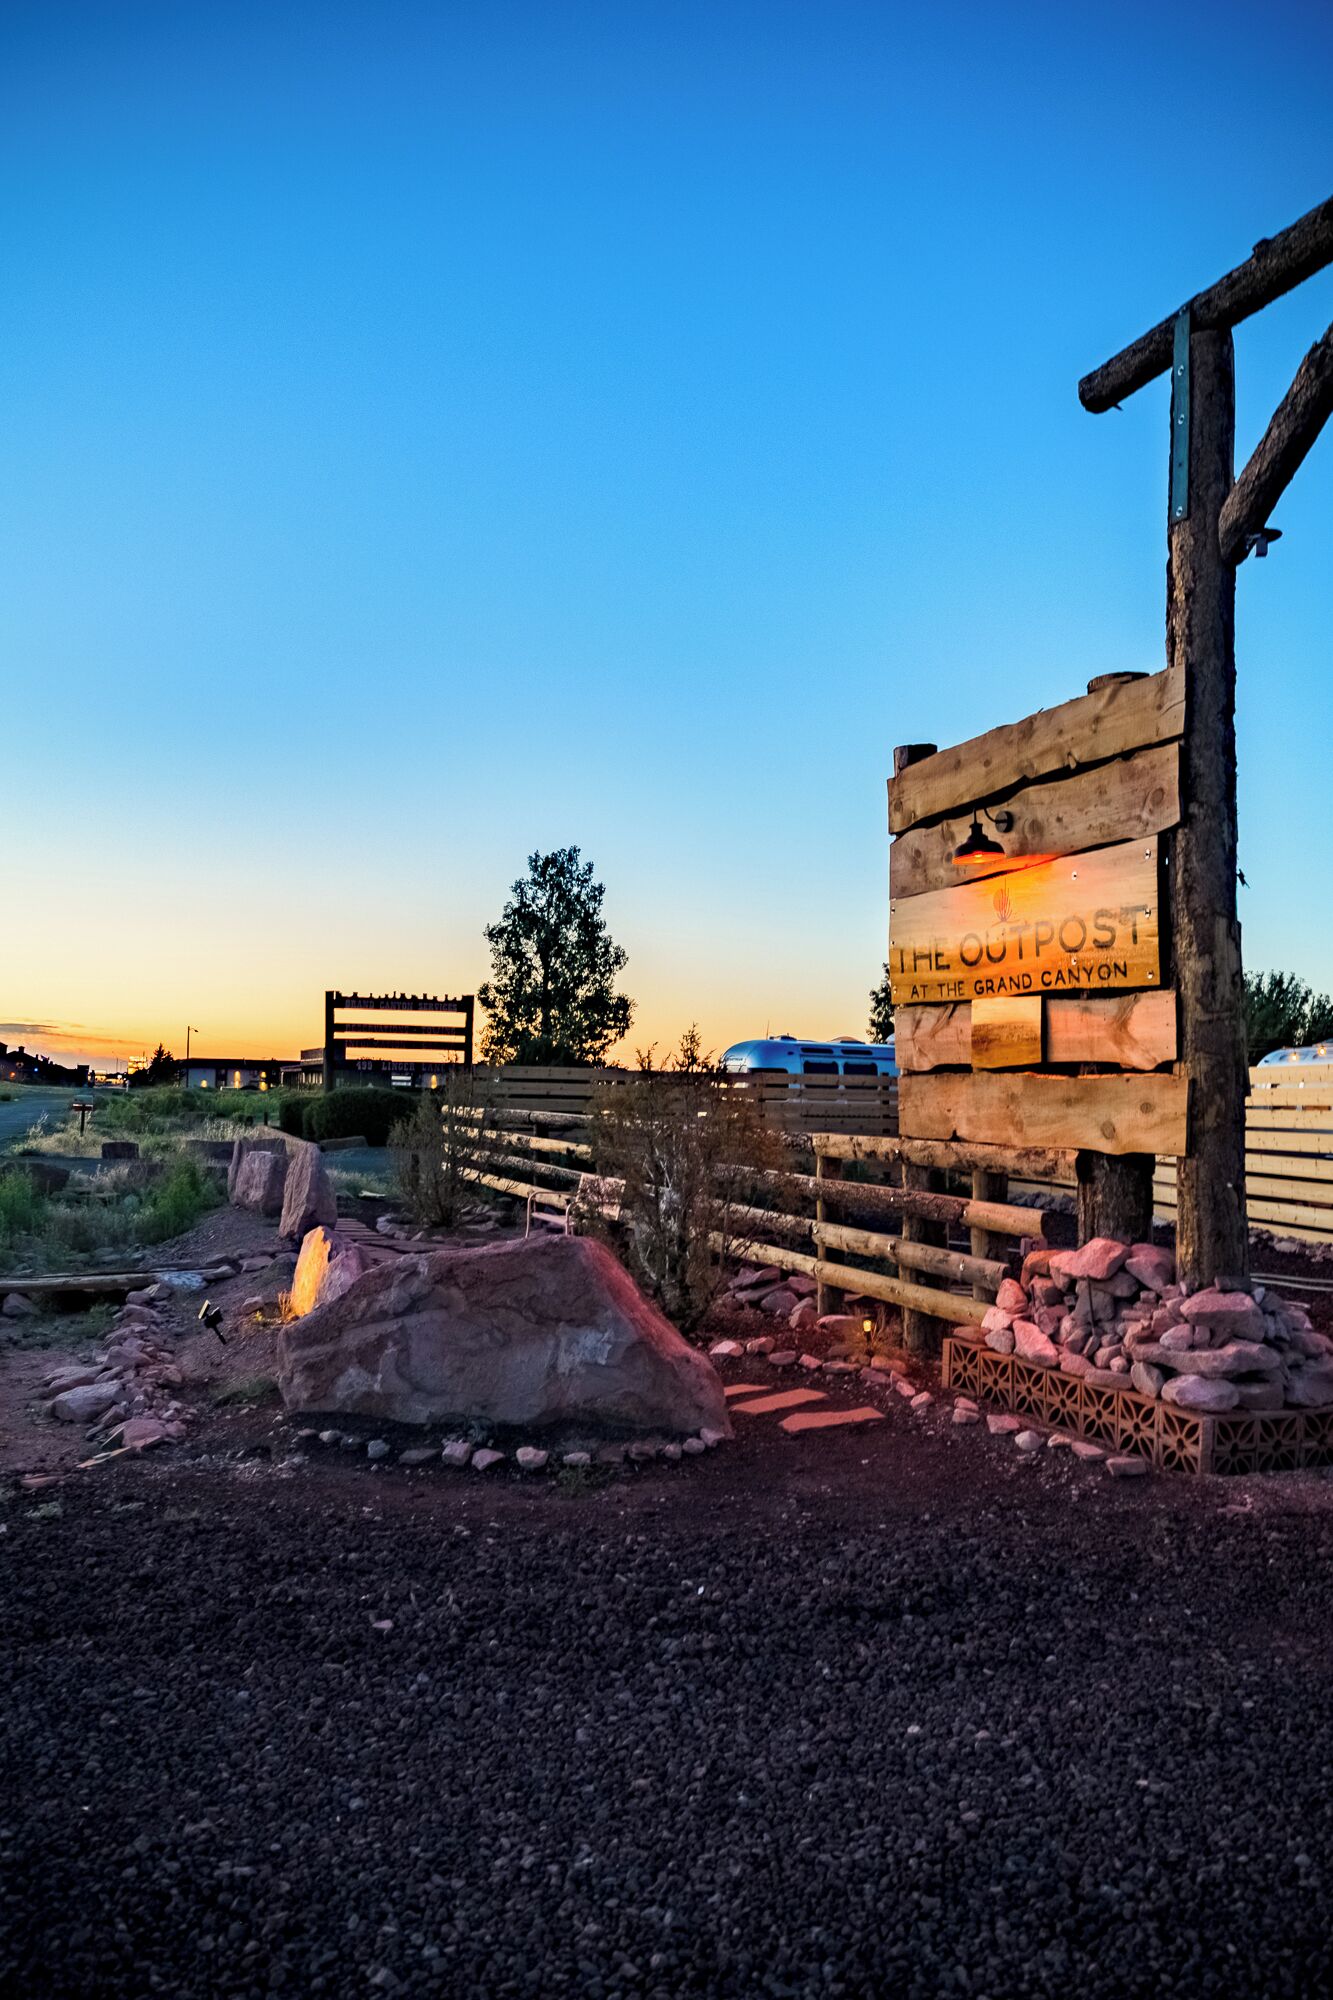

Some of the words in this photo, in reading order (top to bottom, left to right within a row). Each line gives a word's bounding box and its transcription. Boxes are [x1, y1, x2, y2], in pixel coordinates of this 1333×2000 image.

[899, 938, 950, 973] THE
[959, 904, 1149, 966] OUTPOST
[911, 984, 928, 999] AT
[937, 980, 965, 997] THE
[974, 973, 1032, 995] GRAND
[1041, 961, 1127, 987] CANYON
[380, 1000, 413, 1010] CANYON
[418, 1001, 457, 1012] SERVICES
